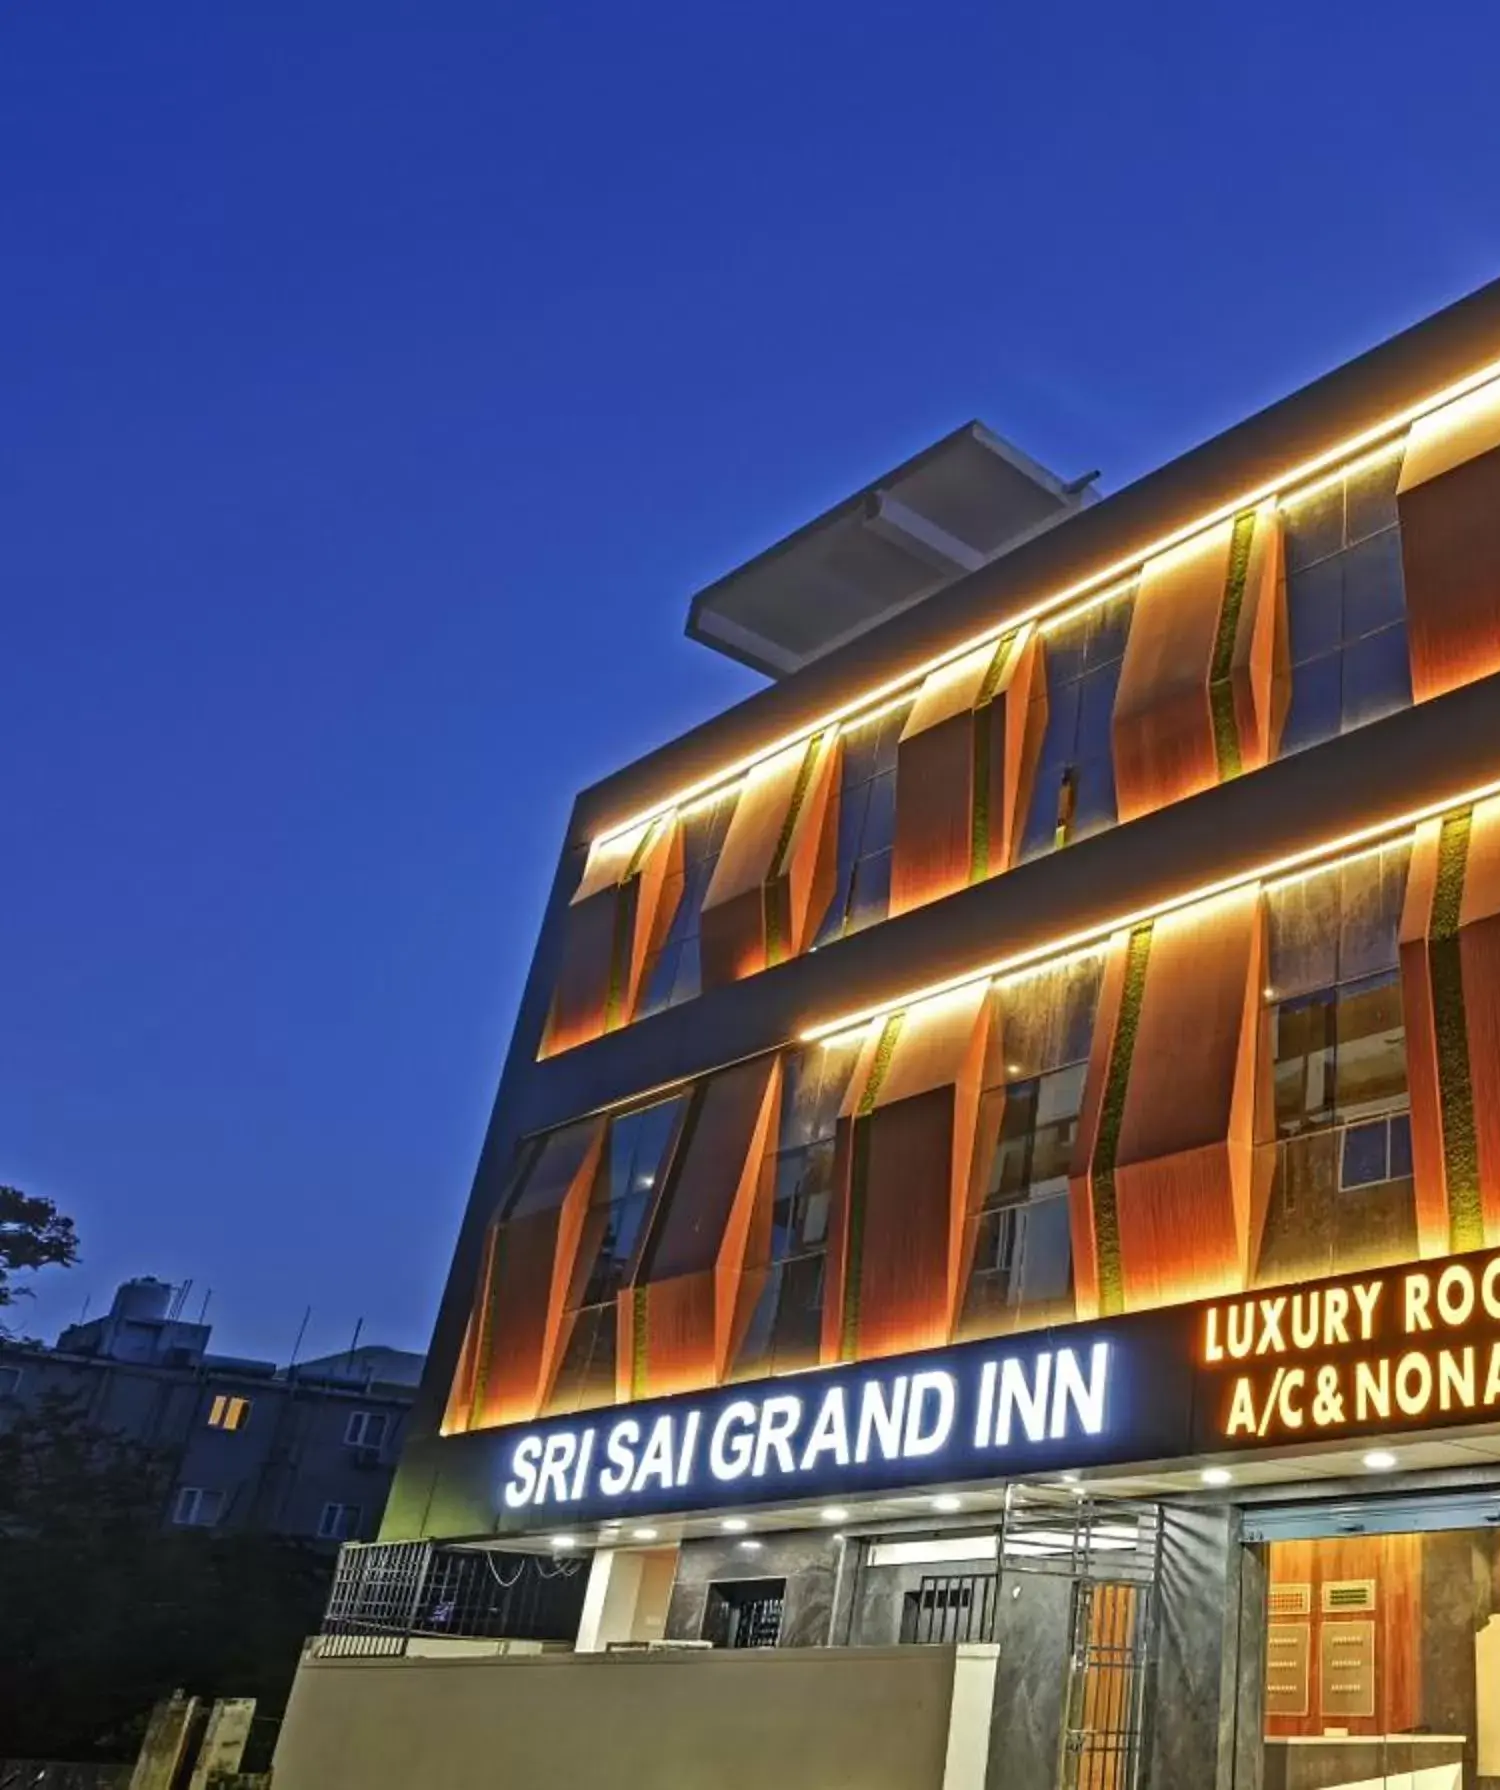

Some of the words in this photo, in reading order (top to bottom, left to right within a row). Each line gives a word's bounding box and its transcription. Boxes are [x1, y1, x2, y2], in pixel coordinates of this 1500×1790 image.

[1204, 1280, 1383, 1362] LUXURY
[504, 1428, 595, 1508] SRI
[599, 1411, 702, 1496] SAI
[709, 1370, 956, 1481] GRAND
[974, 1342, 1109, 1448] INN
